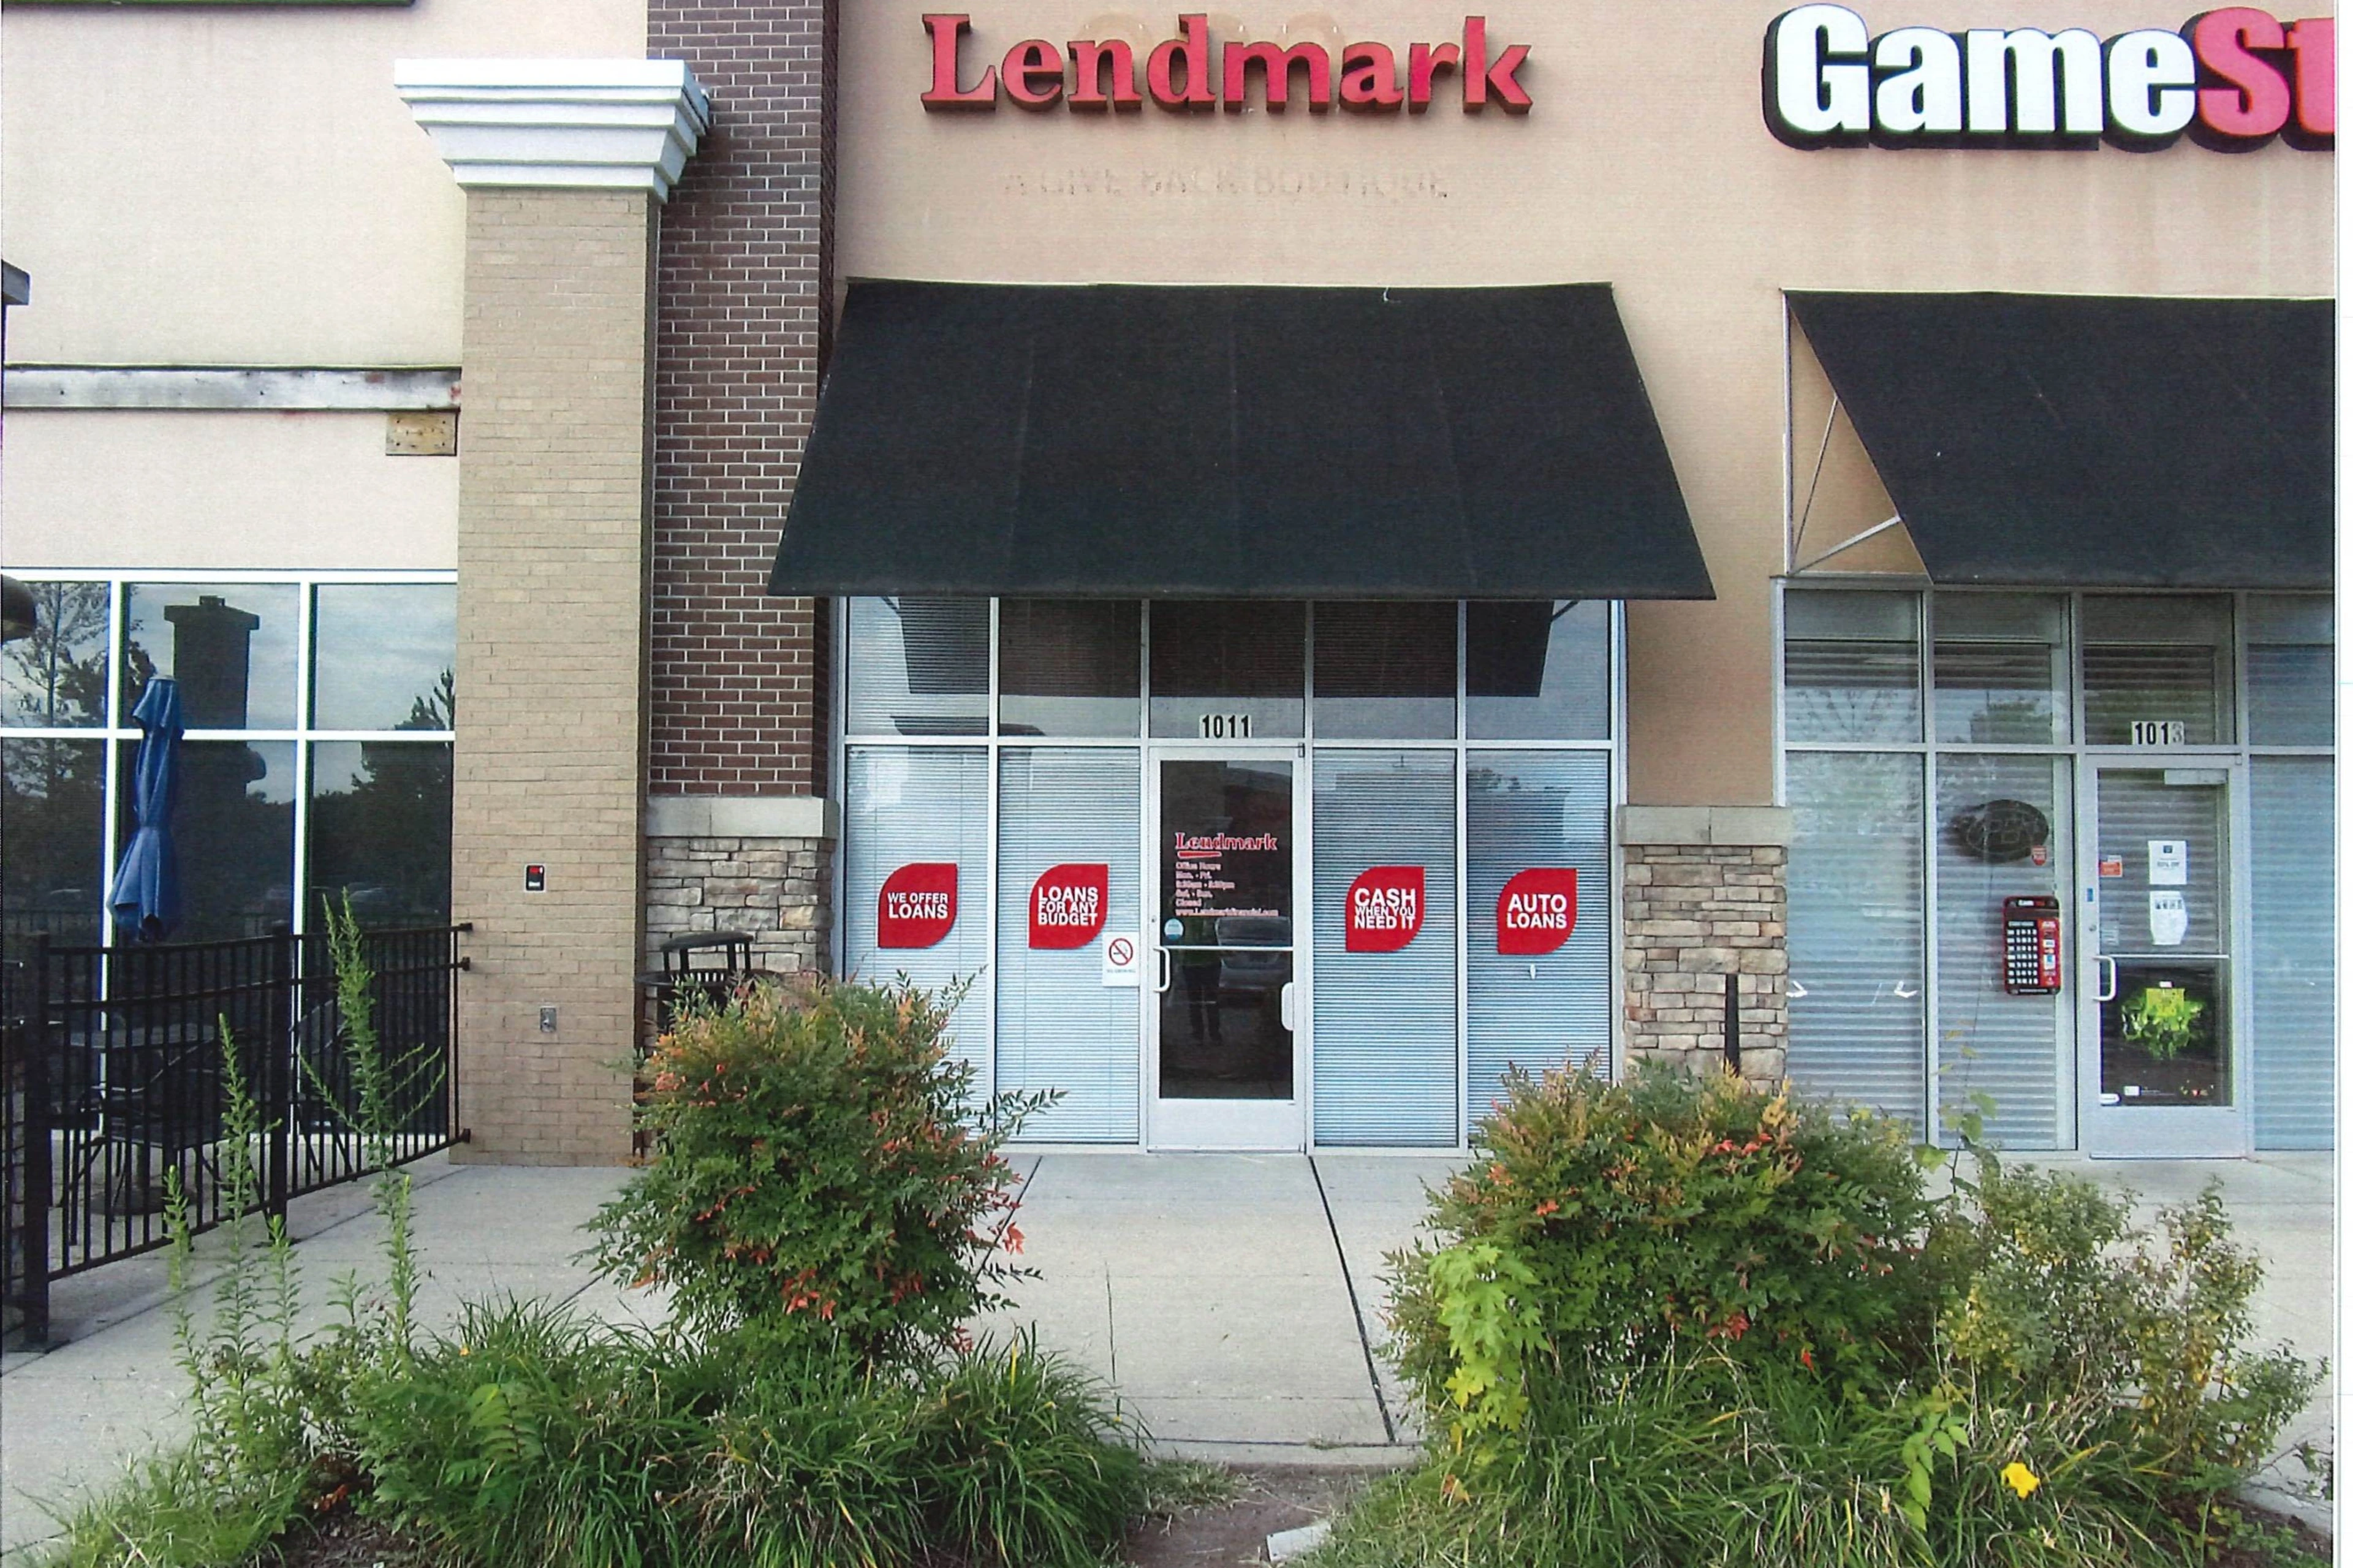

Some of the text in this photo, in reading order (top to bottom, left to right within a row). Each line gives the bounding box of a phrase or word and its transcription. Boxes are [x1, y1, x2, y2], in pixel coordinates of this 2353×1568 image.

[920, 13, 1532, 115] Lendmark
[1202, 714, 1248, 738] 1011
[2135, 722, 2182, 745] 1013
[1175, 832, 1278, 850] Lendmark
[888, 892, 948, 904] WE OFFER
[1039, 886, 1099, 903] LOANS
[1354, 888, 1416, 907] CASH
[1039, 902, 1098, 913] FOR ANY
[1508, 893, 1567, 913] AUTO
[889, 904, 948, 919] LOANS
[1038, 912, 1098, 926] BUDGET
[1355, 906, 1415, 917] WHEN YOU
[1354, 915, 1416, 930] NEED IT
[1507, 913, 1567, 929] LOANS
